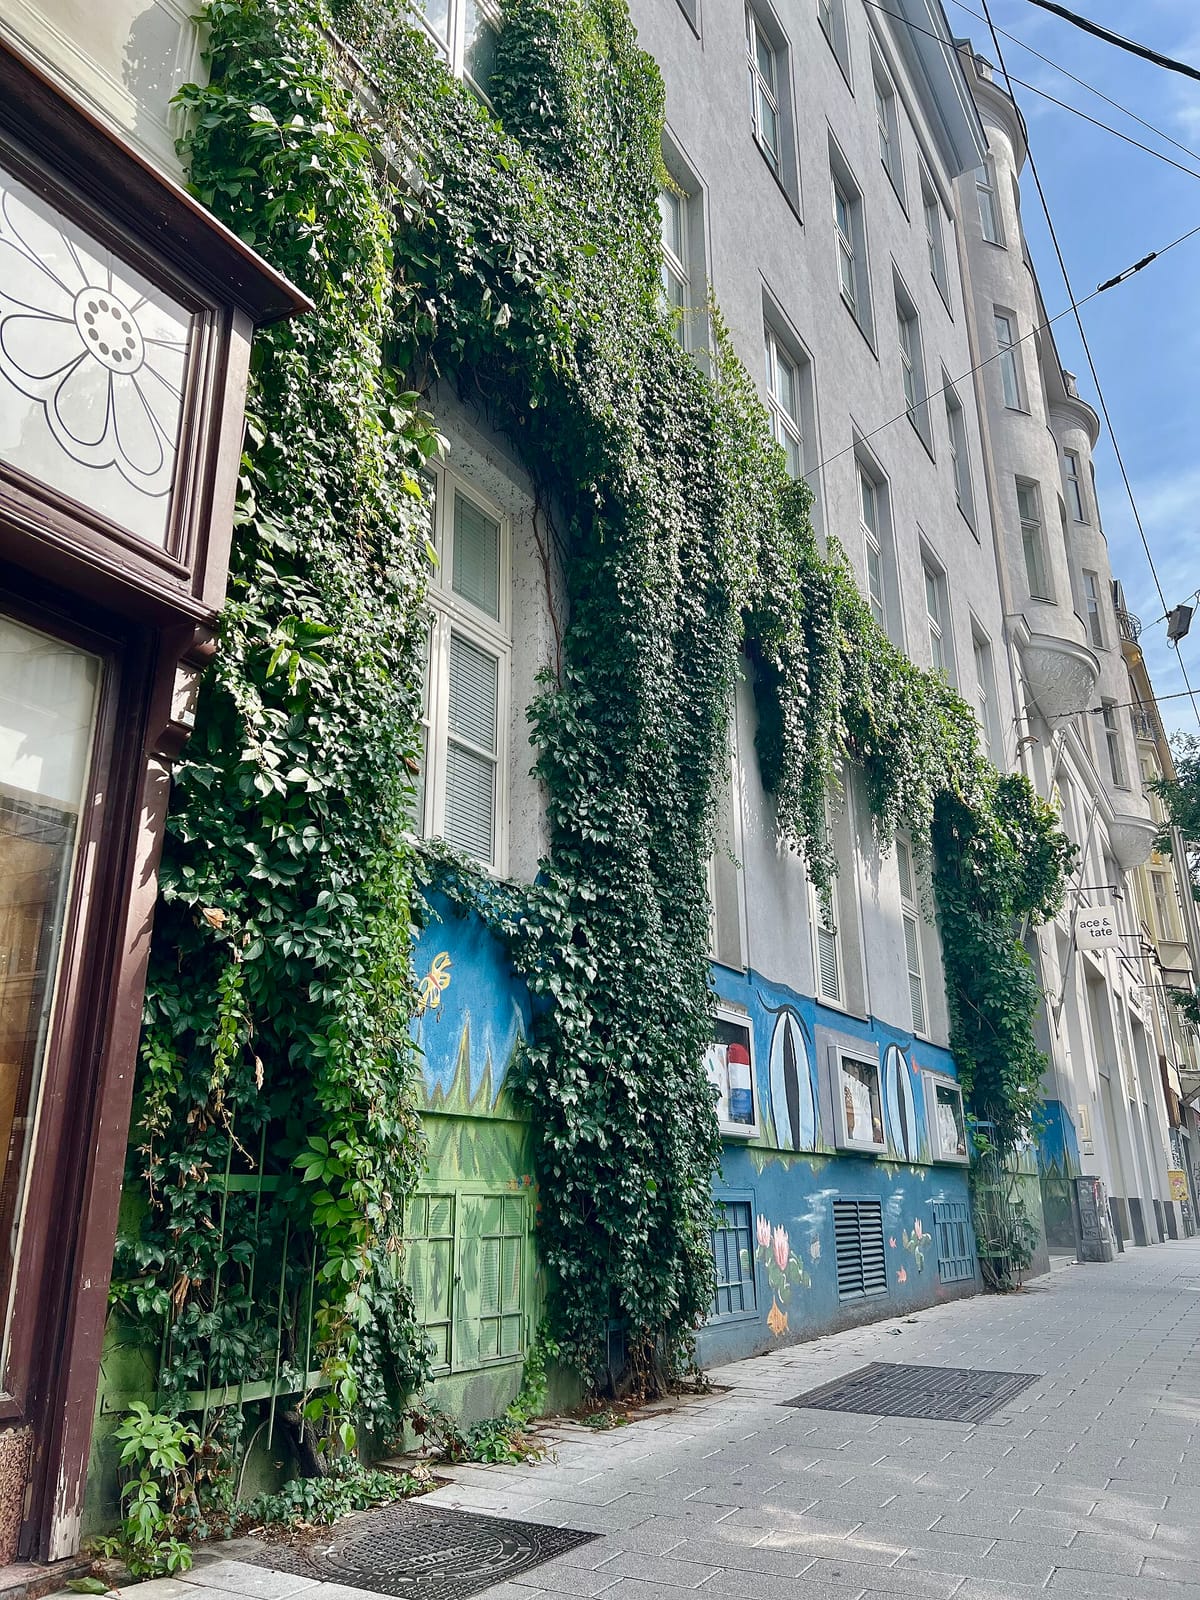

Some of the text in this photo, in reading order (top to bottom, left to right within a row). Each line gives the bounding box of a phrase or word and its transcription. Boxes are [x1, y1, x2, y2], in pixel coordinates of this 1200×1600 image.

[1080, 918, 1111, 928] ace &
[1089, 928, 1113, 937] tate
